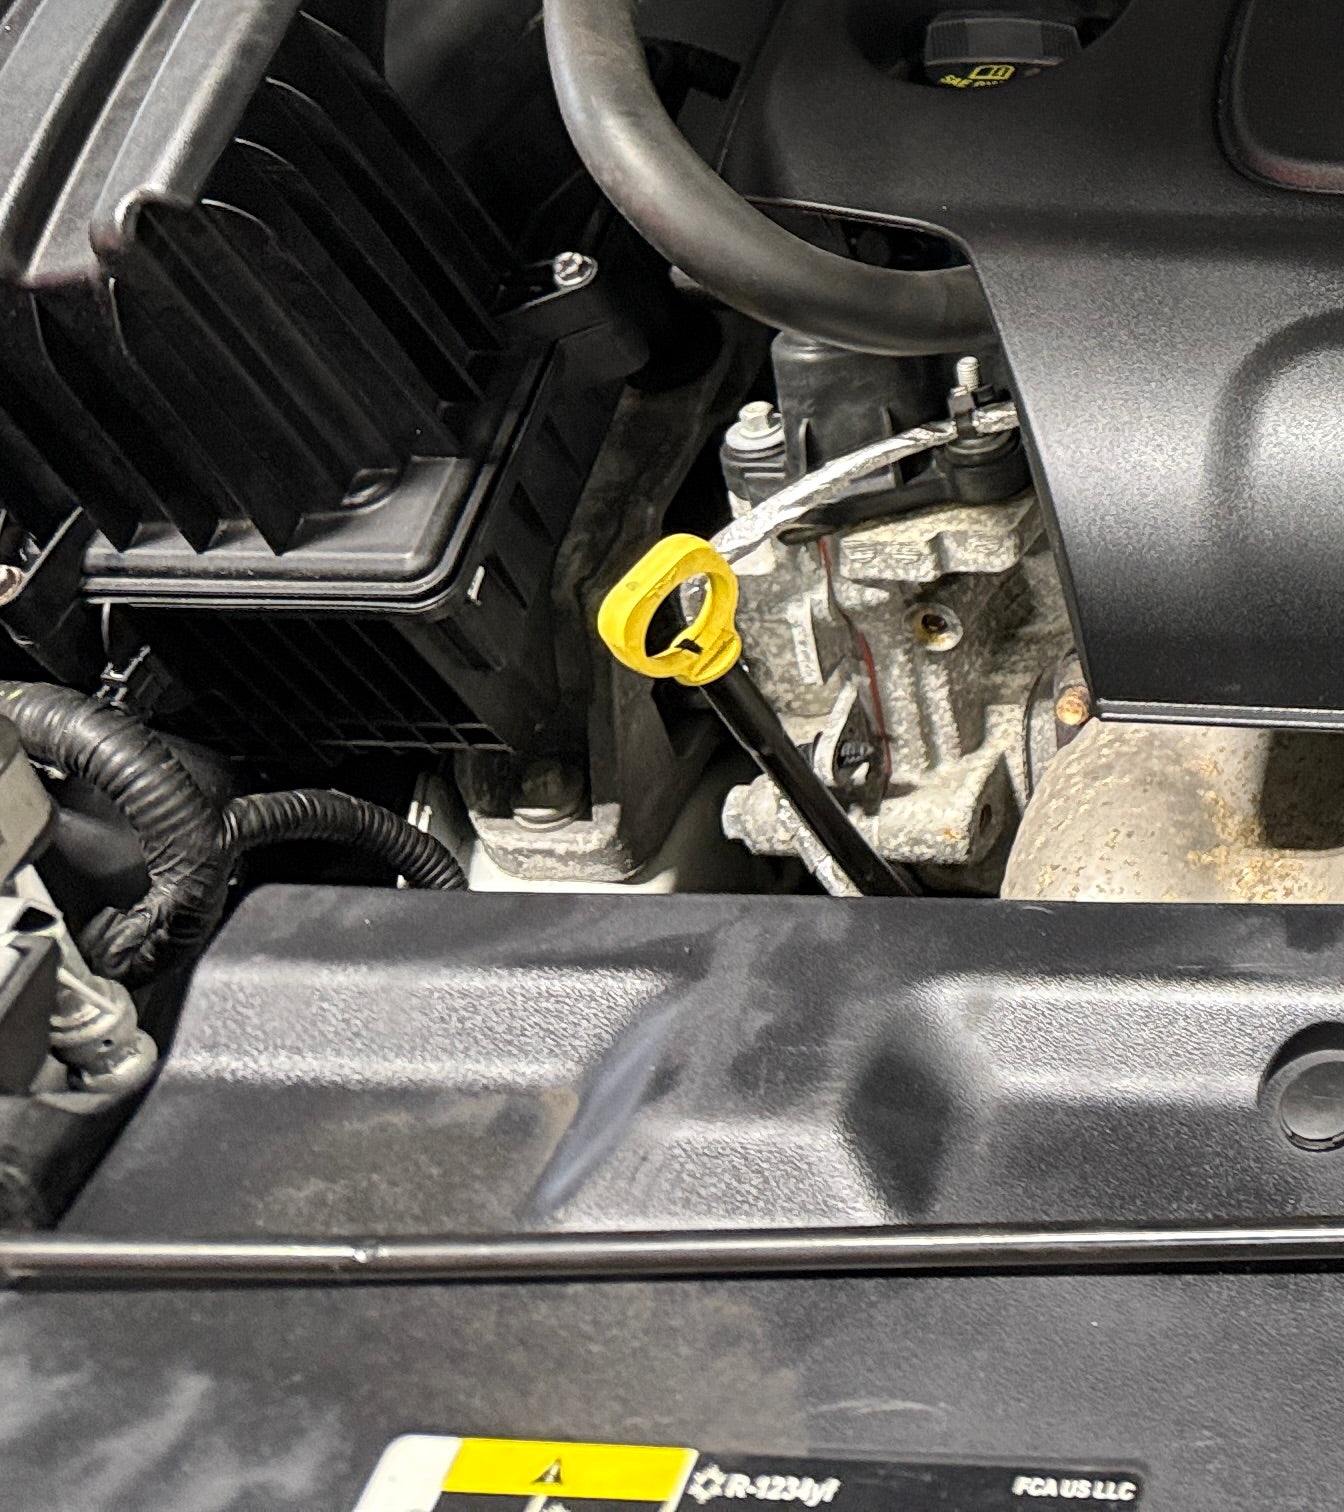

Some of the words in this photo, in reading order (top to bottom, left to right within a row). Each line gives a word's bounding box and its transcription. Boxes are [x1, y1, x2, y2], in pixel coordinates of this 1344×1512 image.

[1012, 1475, 1058, 1497] FCA
[1060, 1478, 1092, 1499] US
[1092, 1479, 1137, 1501] LLC
